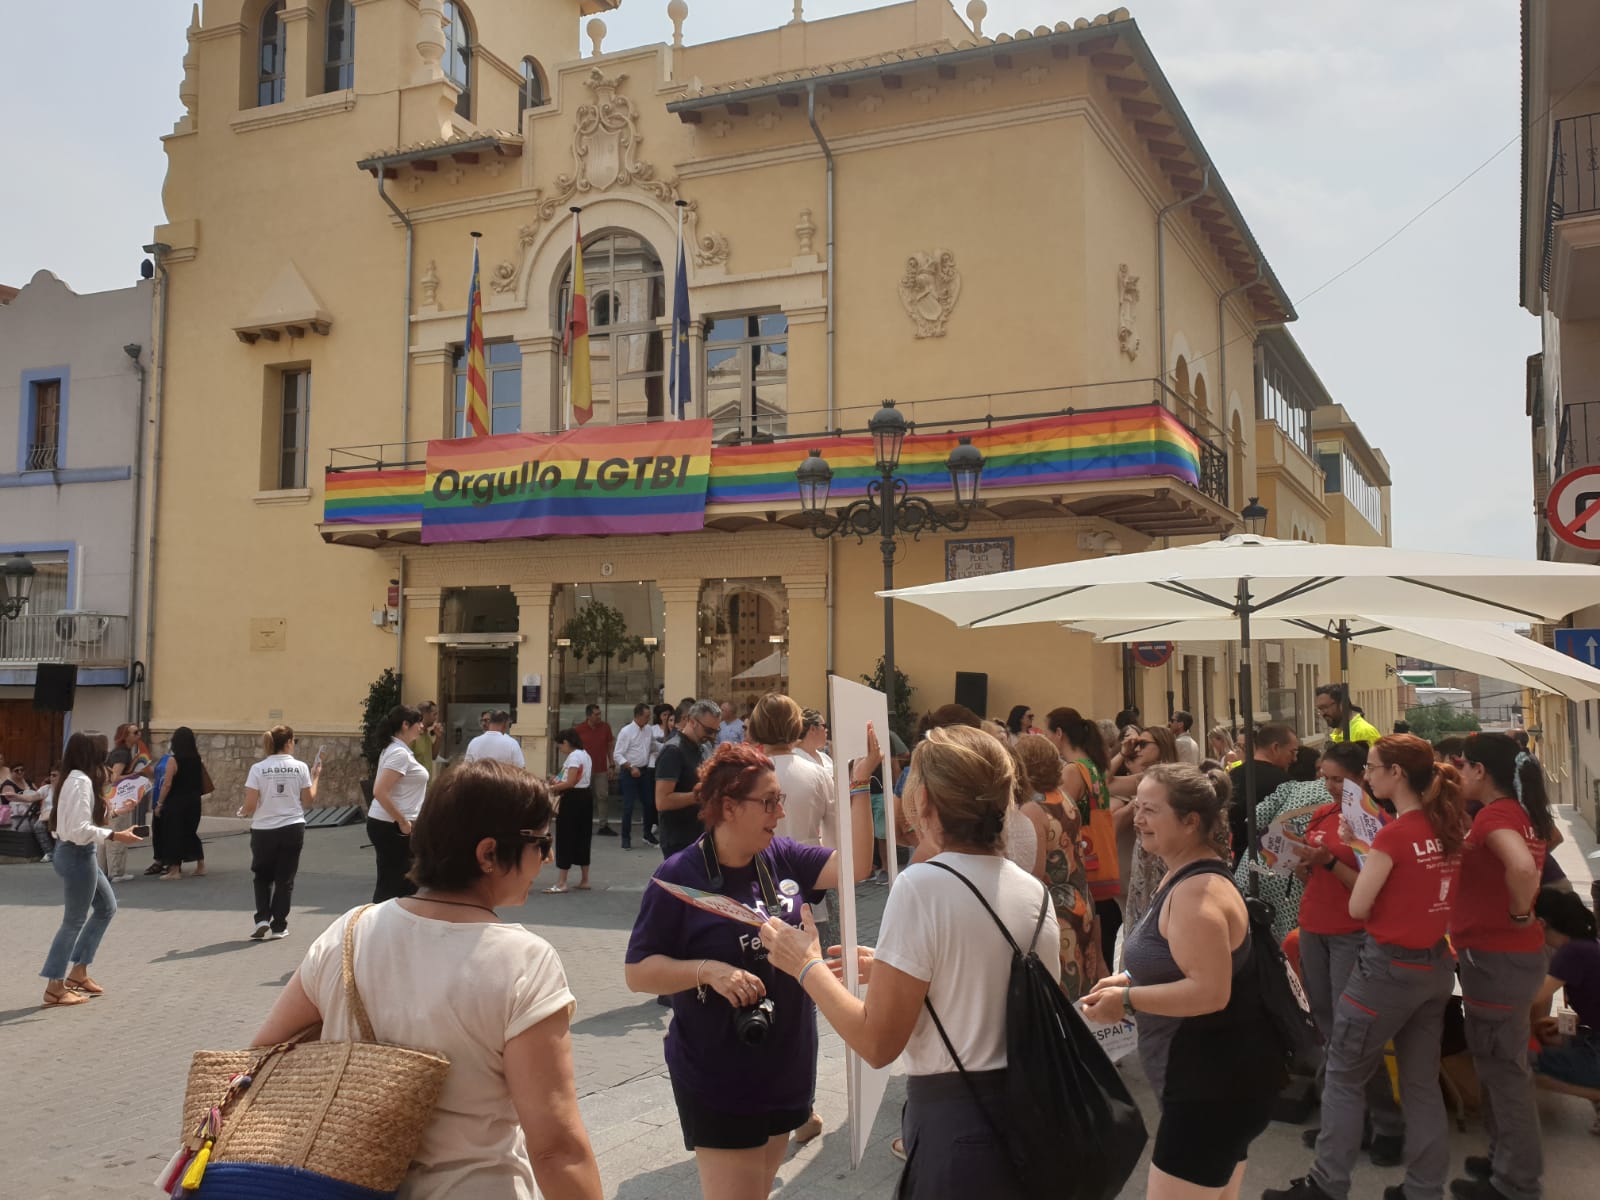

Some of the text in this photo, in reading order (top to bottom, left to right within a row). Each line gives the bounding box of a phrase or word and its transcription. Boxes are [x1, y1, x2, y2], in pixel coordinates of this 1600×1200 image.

[432, 454, 691, 508] Orgullo LGTBI
[262, 767, 300, 775] LABORA
[1412, 838, 1444, 857] LAB
